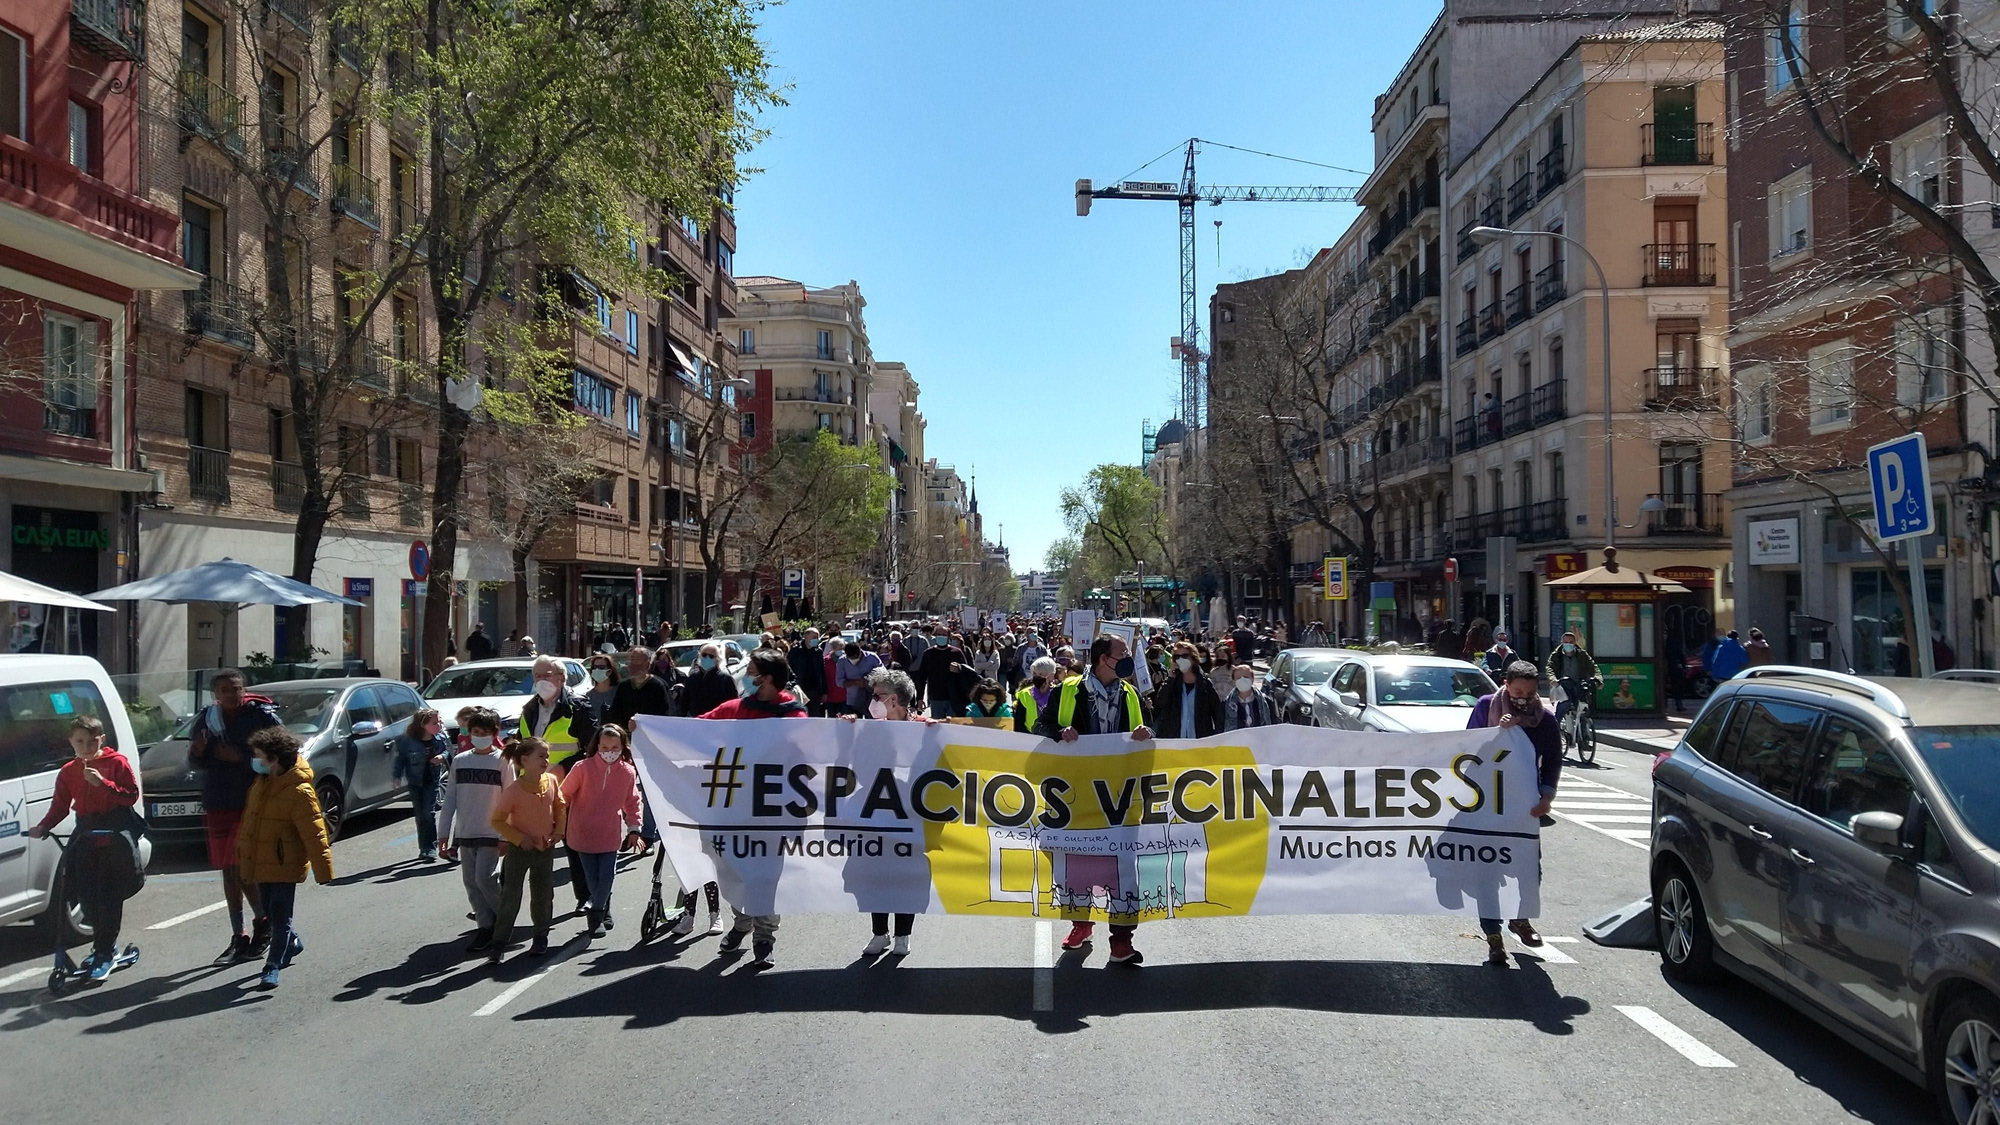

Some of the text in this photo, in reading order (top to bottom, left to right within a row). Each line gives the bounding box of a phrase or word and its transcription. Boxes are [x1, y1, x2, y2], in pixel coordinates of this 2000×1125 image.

[1878, 451, 1906, 528] P
[1900, 518, 1908, 532] 3
[12, 525, 111, 551] CASA ELIAS
[784, 569, 801, 586] P
[161, 804, 186, 815] 2698
[994, 831, 1040, 841] CASA
[777, 834, 883, 857] Madrid
[893, 842, 912, 857] a
[1109, 839, 1201, 852] CIUDADANA
[1280, 835, 1512, 864] Muchas Manos
